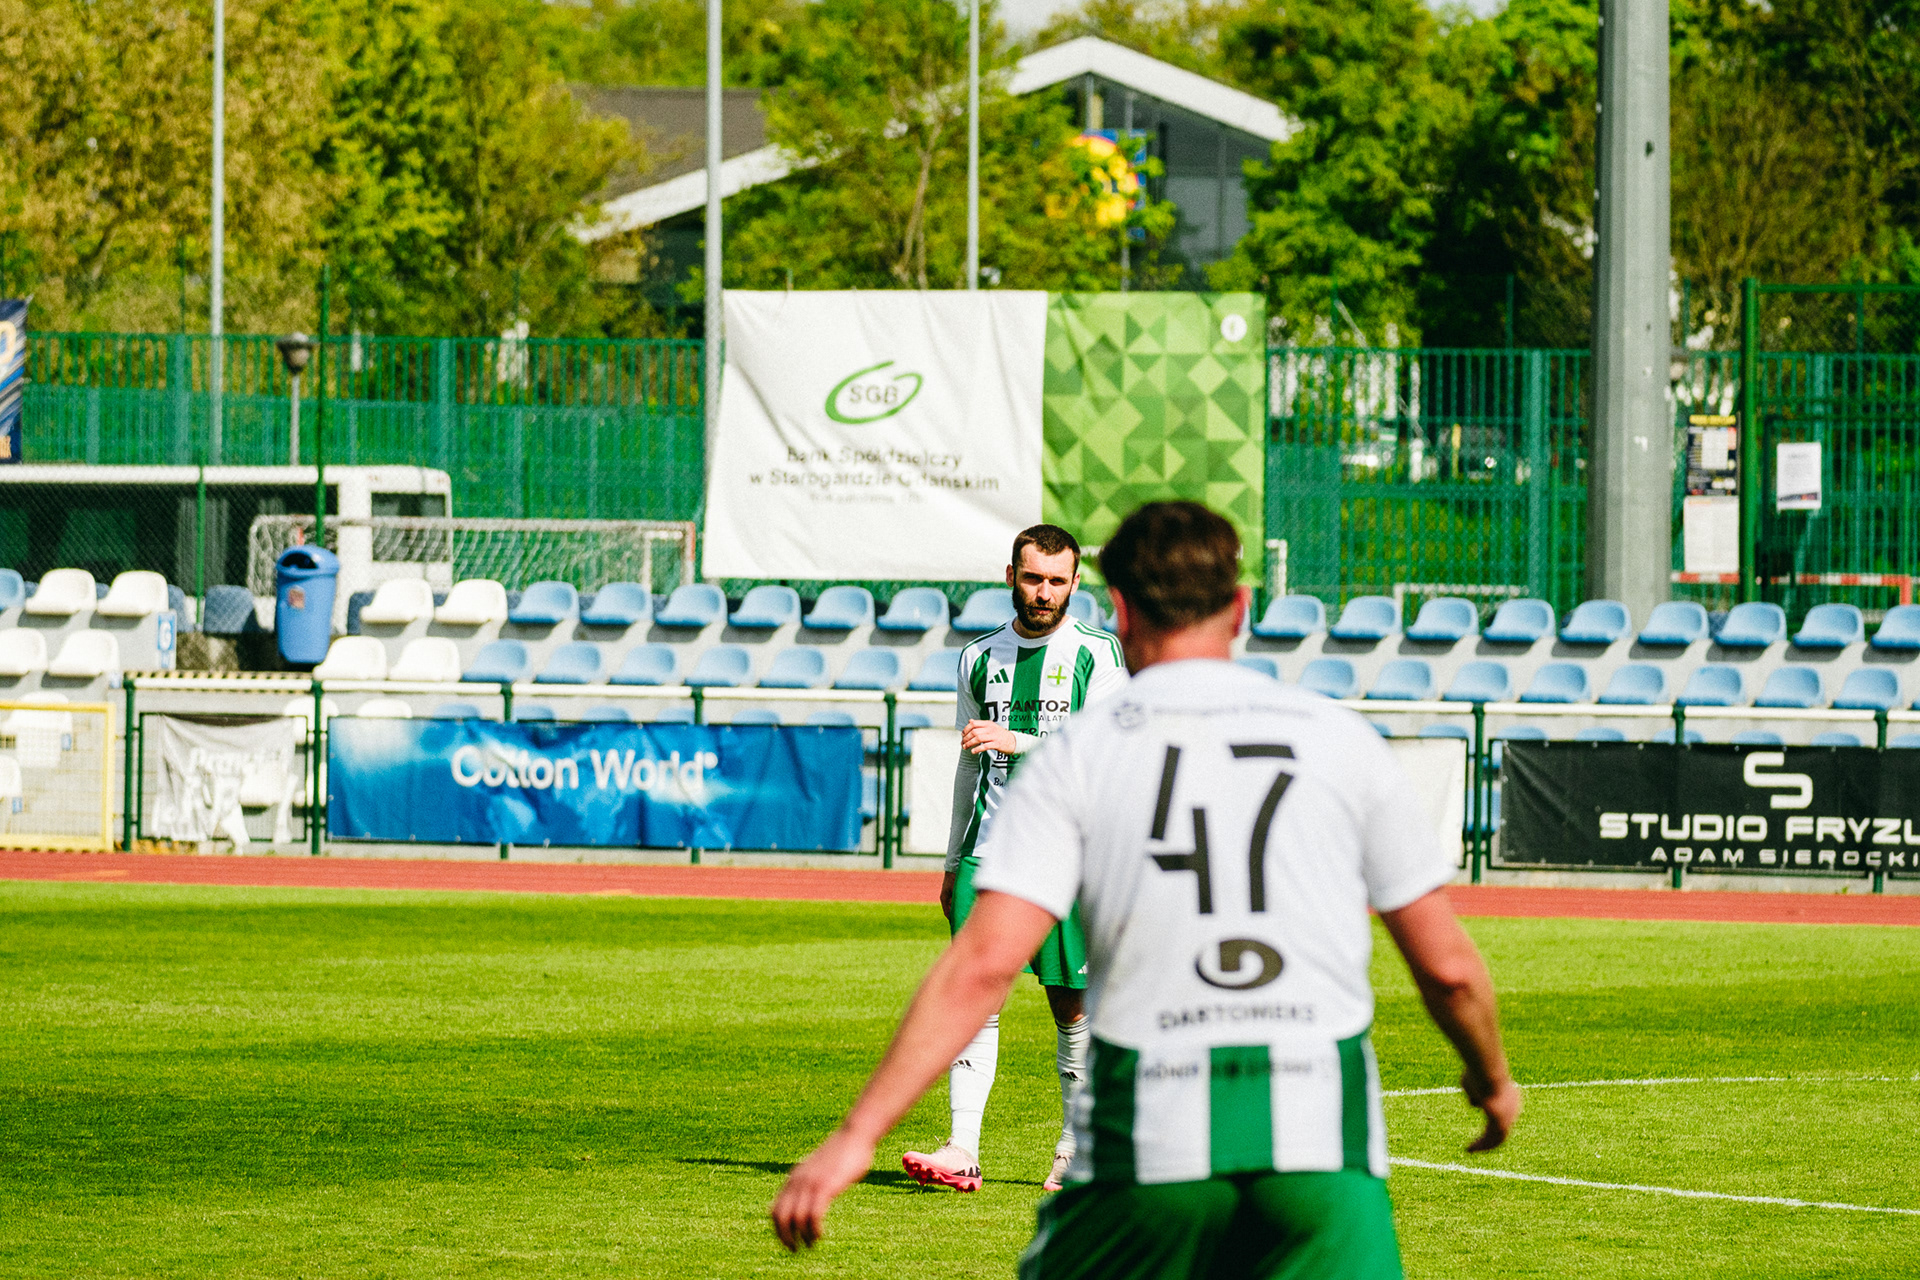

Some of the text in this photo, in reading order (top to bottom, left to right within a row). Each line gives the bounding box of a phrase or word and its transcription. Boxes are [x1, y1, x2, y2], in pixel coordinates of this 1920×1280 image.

[849, 384, 898, 404] SGB
[787, 446, 831, 464] Bank
[750, 472, 763, 484] w
[769, 468, 891, 488] Starogardzie
[1001, 699, 1070, 713] PANTOR
[1001, 714, 1030, 722] DRZWI
[1033, 714, 1044, 722] NA
[452, 745, 579, 790] Cotton
[1150, 743, 1296, 915] 47
[1599, 812, 1768, 842] STUDIO
[1651, 847, 1919, 868] ADAM SIEROCKI
